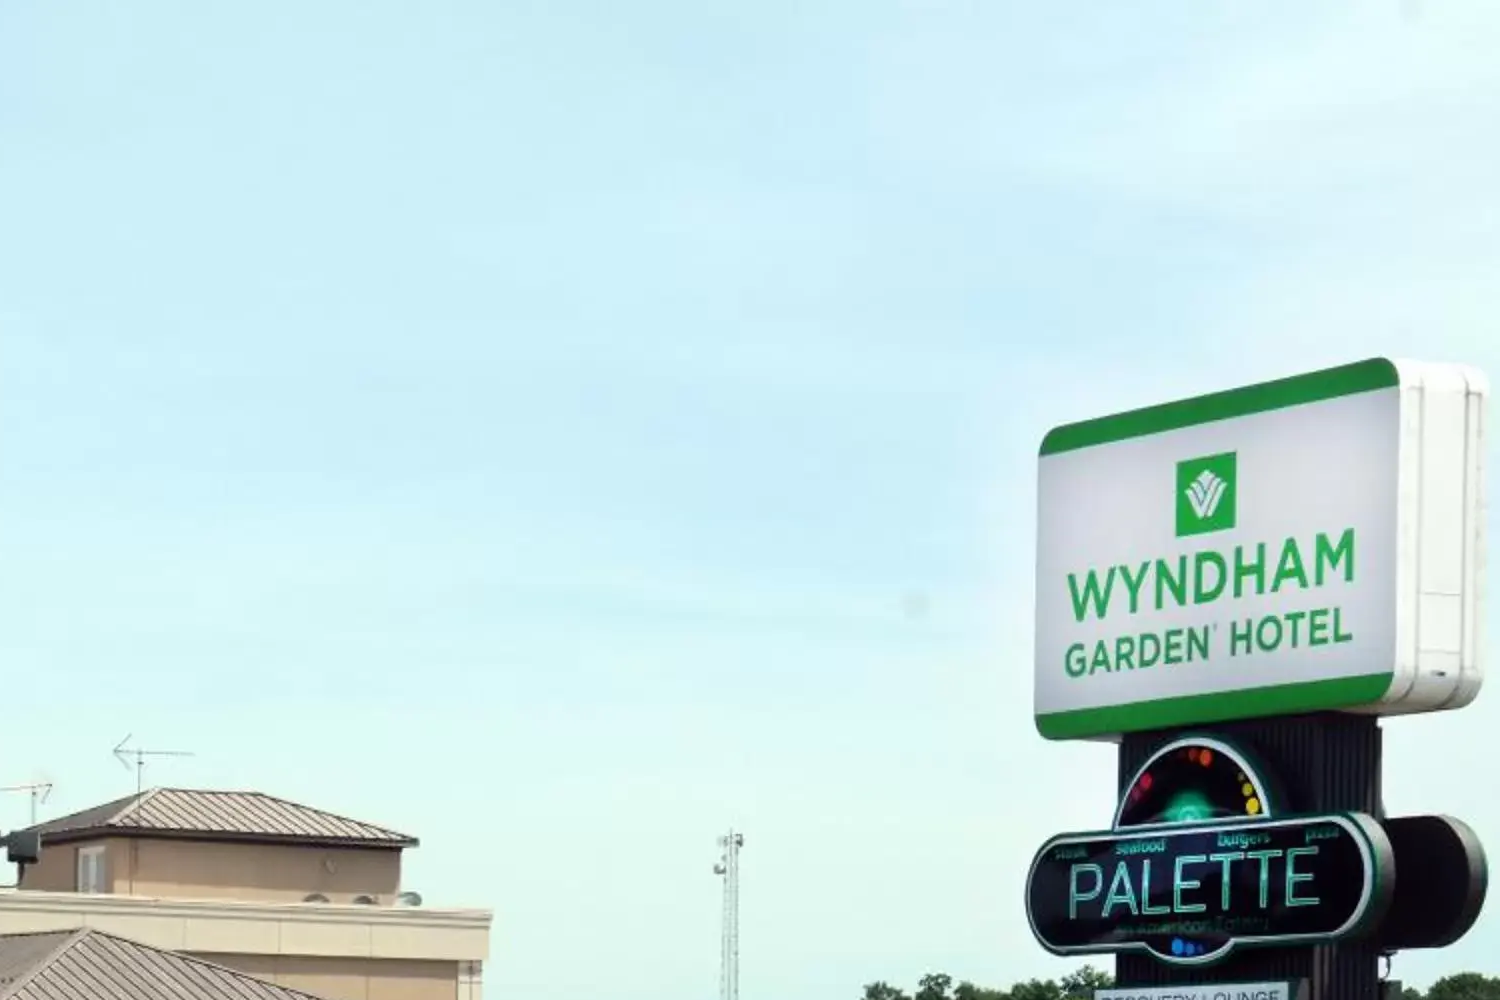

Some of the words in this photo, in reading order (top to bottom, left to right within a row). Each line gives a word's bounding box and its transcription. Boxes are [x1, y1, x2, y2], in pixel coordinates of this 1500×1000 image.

[1066, 527, 1355, 623] WYNDHAM
[1064, 624, 1210, 678] GARDEN
[1229, 606, 1353, 657] HOTEL
[1217, 832, 1271, 849] burgers
[1068, 845, 1320, 920] PALETTE
